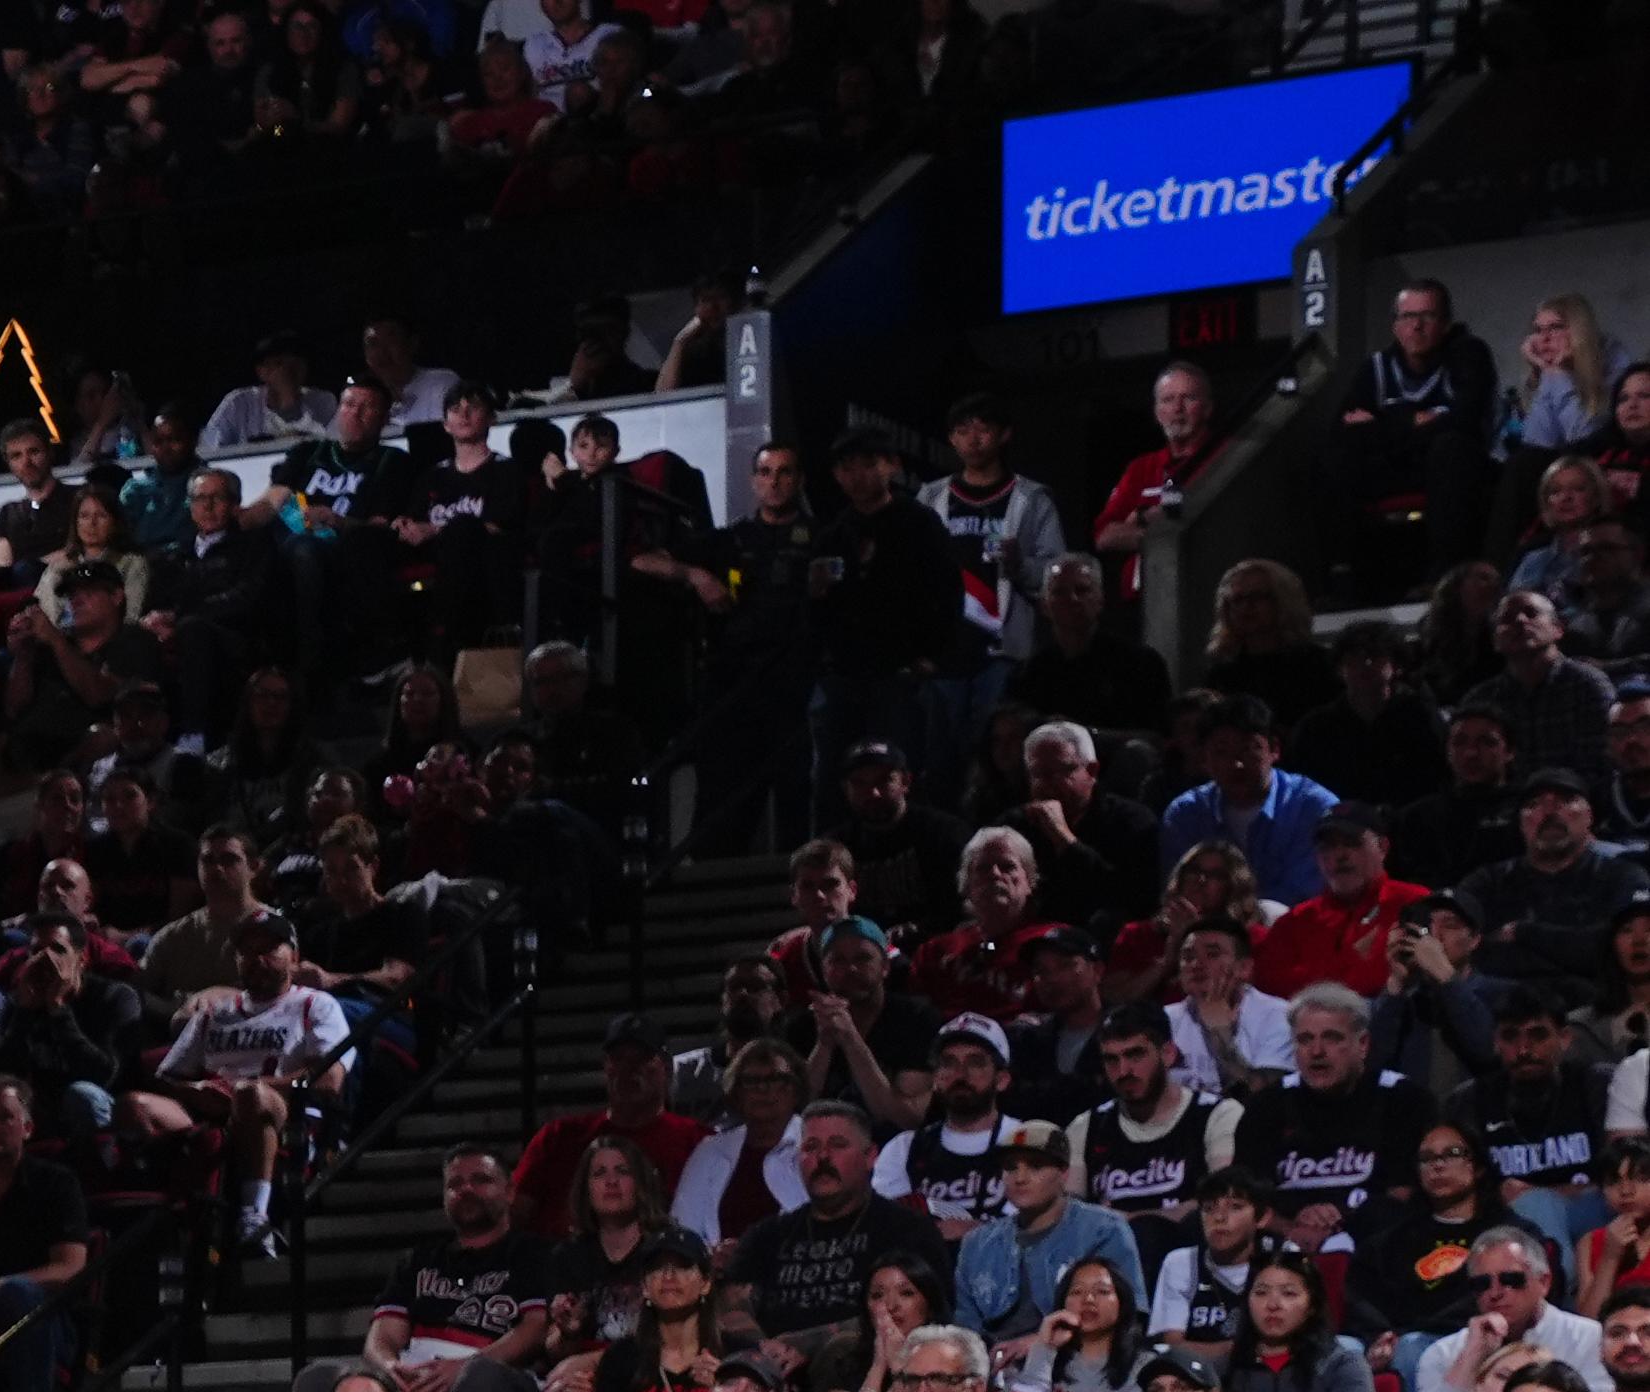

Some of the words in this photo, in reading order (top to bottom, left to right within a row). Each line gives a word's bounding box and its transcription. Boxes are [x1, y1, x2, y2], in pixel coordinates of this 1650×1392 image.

[1305, 249, 1326, 281] A
[1305, 292, 1325, 326] 2
[740, 323, 758, 356] A
[740, 364, 757, 398] 2
